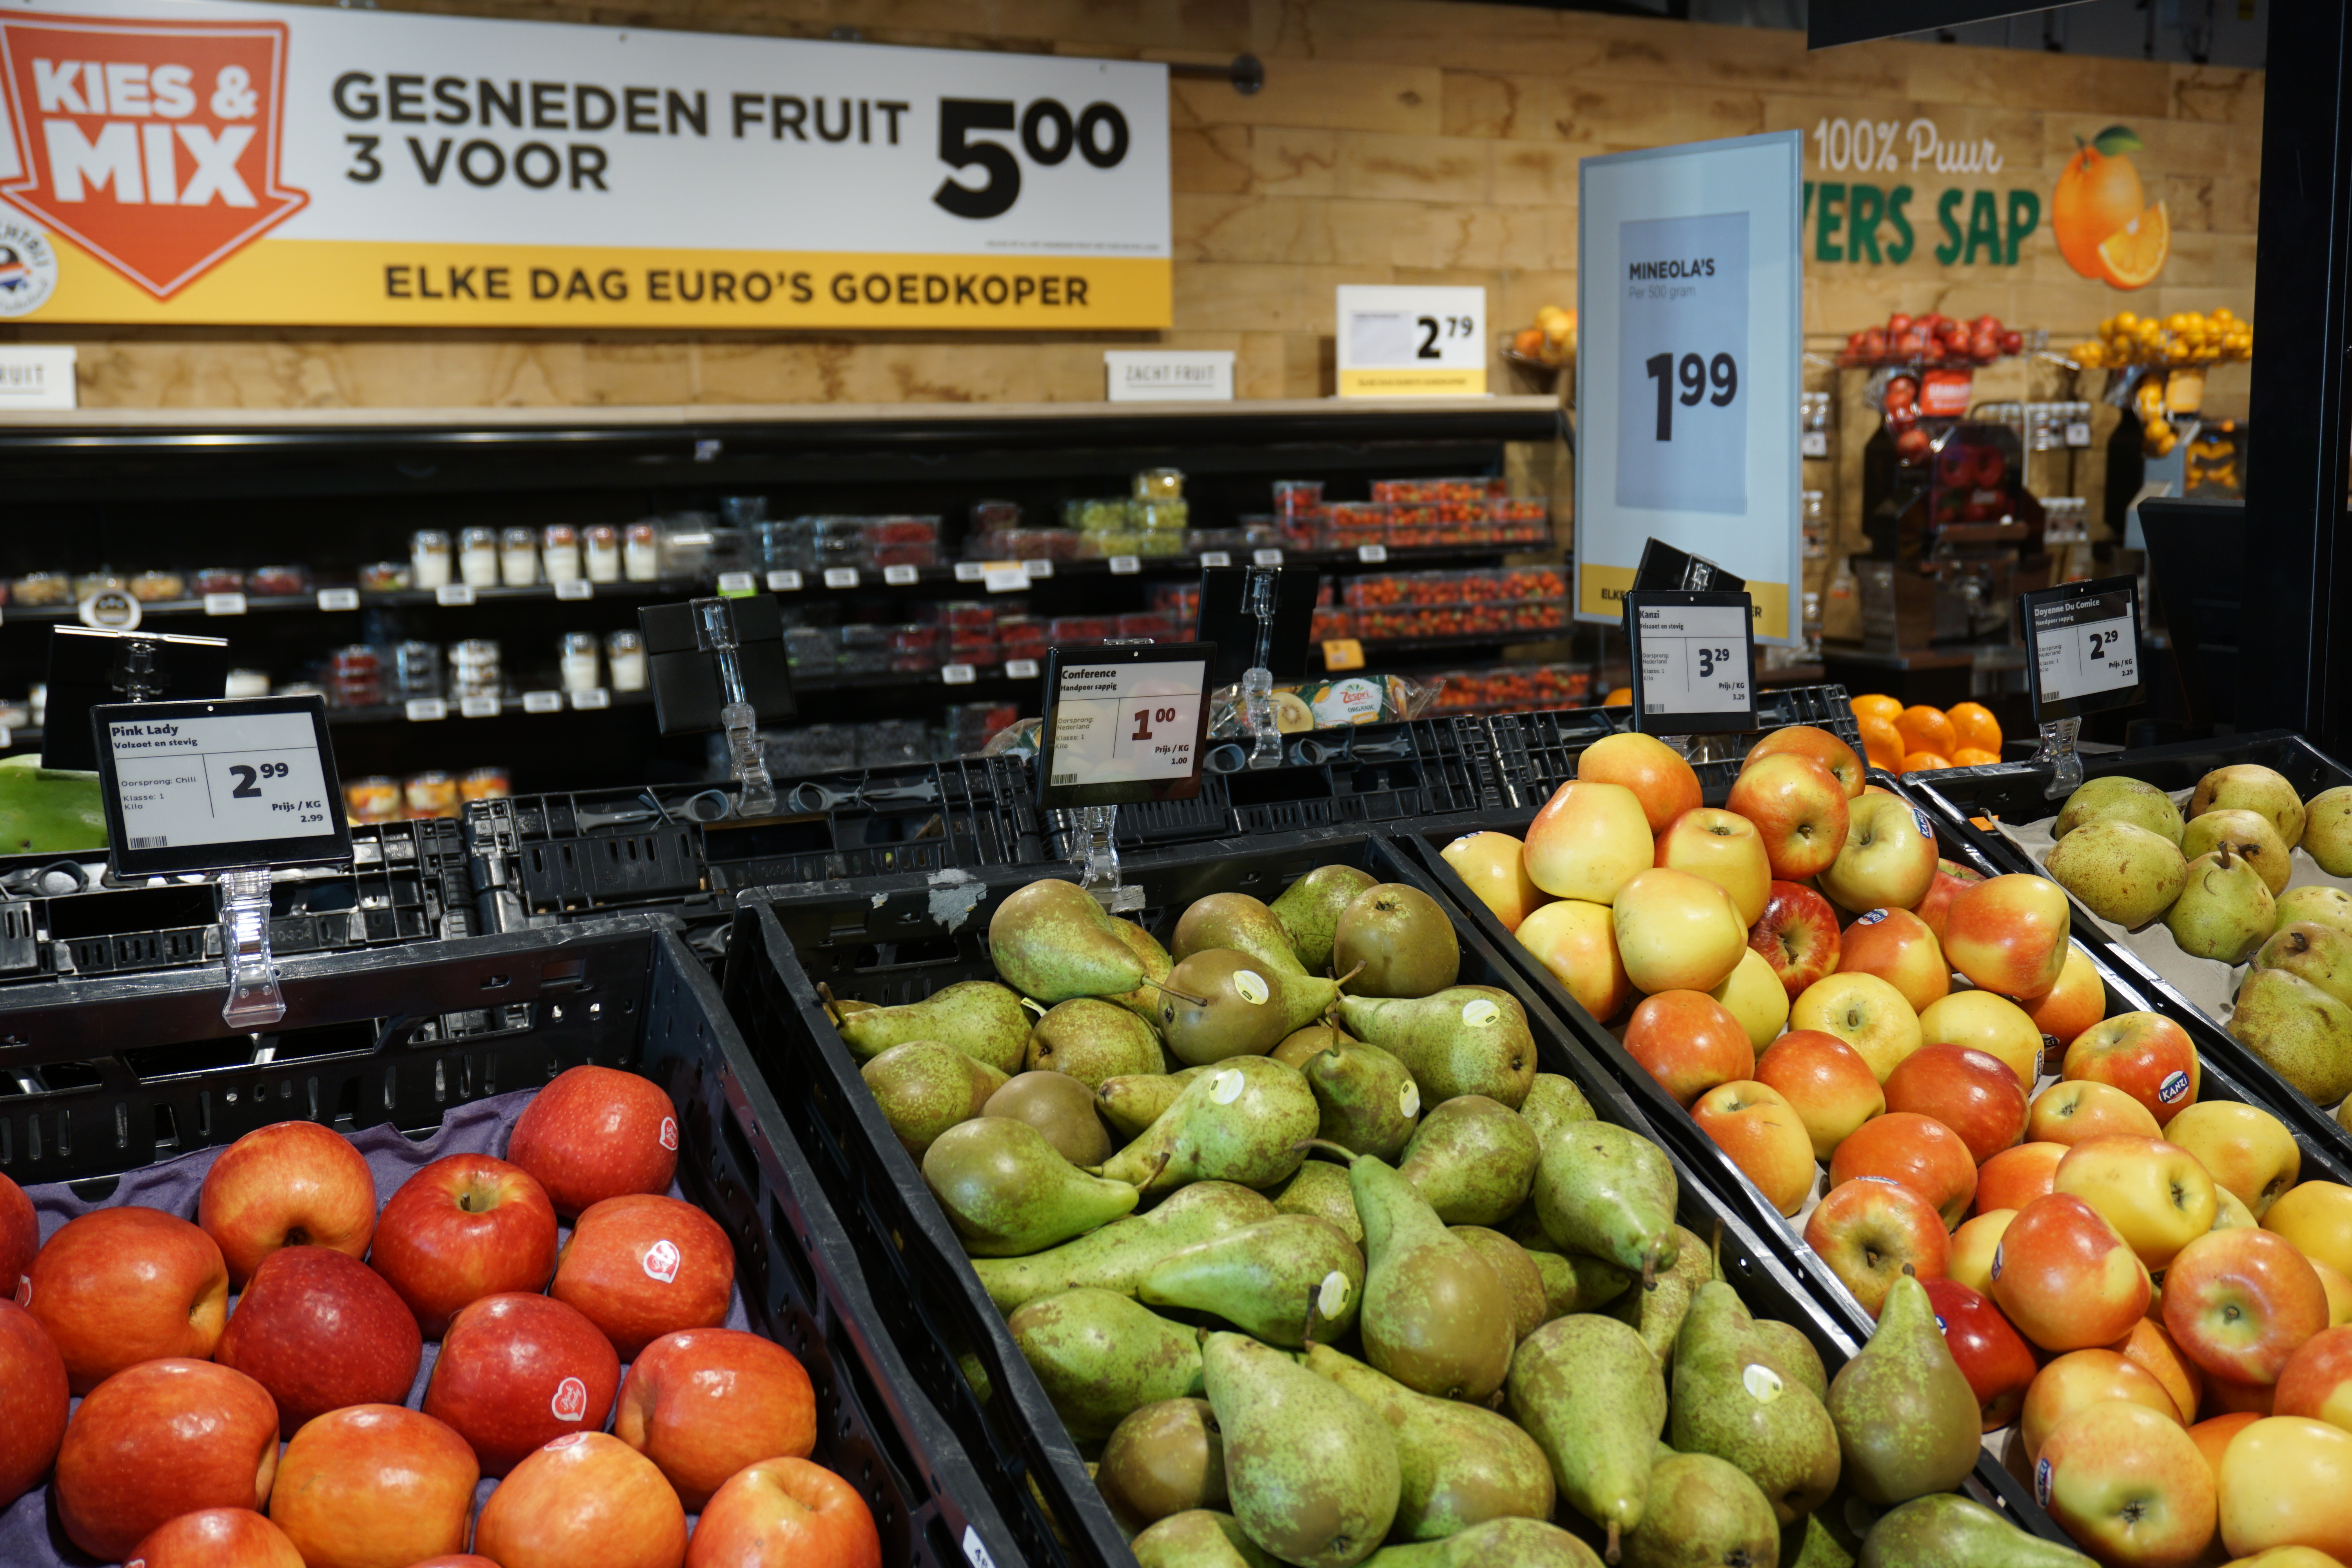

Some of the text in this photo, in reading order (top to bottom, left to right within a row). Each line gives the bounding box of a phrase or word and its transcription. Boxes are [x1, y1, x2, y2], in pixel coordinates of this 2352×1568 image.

[32, 58, 258, 120] KIES &
[332, 71, 911, 146] GESNEDEN FRUIT
[1813, 118, 2004, 174] 100% Puur
[42, 119, 260, 208] MIX
[345, 134, 609, 192] 3 VOOR
[1935, 187, 2041, 267] SAP
[1629, 258, 1715, 280] MINEOLA'S
[384, 265, 1090, 307] ELKE DAG EURO'S GOEDKOPER
[1629, 285, 1696, 299] Per 500 gram
[2034, 598, 2100, 617] Doyenne Du Comice
[1639, 610, 1660, 619] Kanzi
[2058, 614, 2074, 623] sappig
[2038, 650, 2061, 658] Nederland
[1062, 669, 1116, 679] Conference
[1060, 682, 1117, 692] Handpeer sappig
[1719, 682, 1731, 691] Prijs
[1339, 690, 1370, 704] Zespri
[1347, 704, 1376, 713] ORGANIC
[112, 724, 179, 737] Pink Lady
[114, 740, 152, 749] Volzoet
[169, 738, 198, 746] stevig
[1155, 745, 1171, 755] Prijs
[1171, 744, 1176, 754] /
[121, 779, 172, 787] Oorsprong:
[272, 800, 321, 813] Prijs / KG
[300, 814, 323, 822] 2.99
